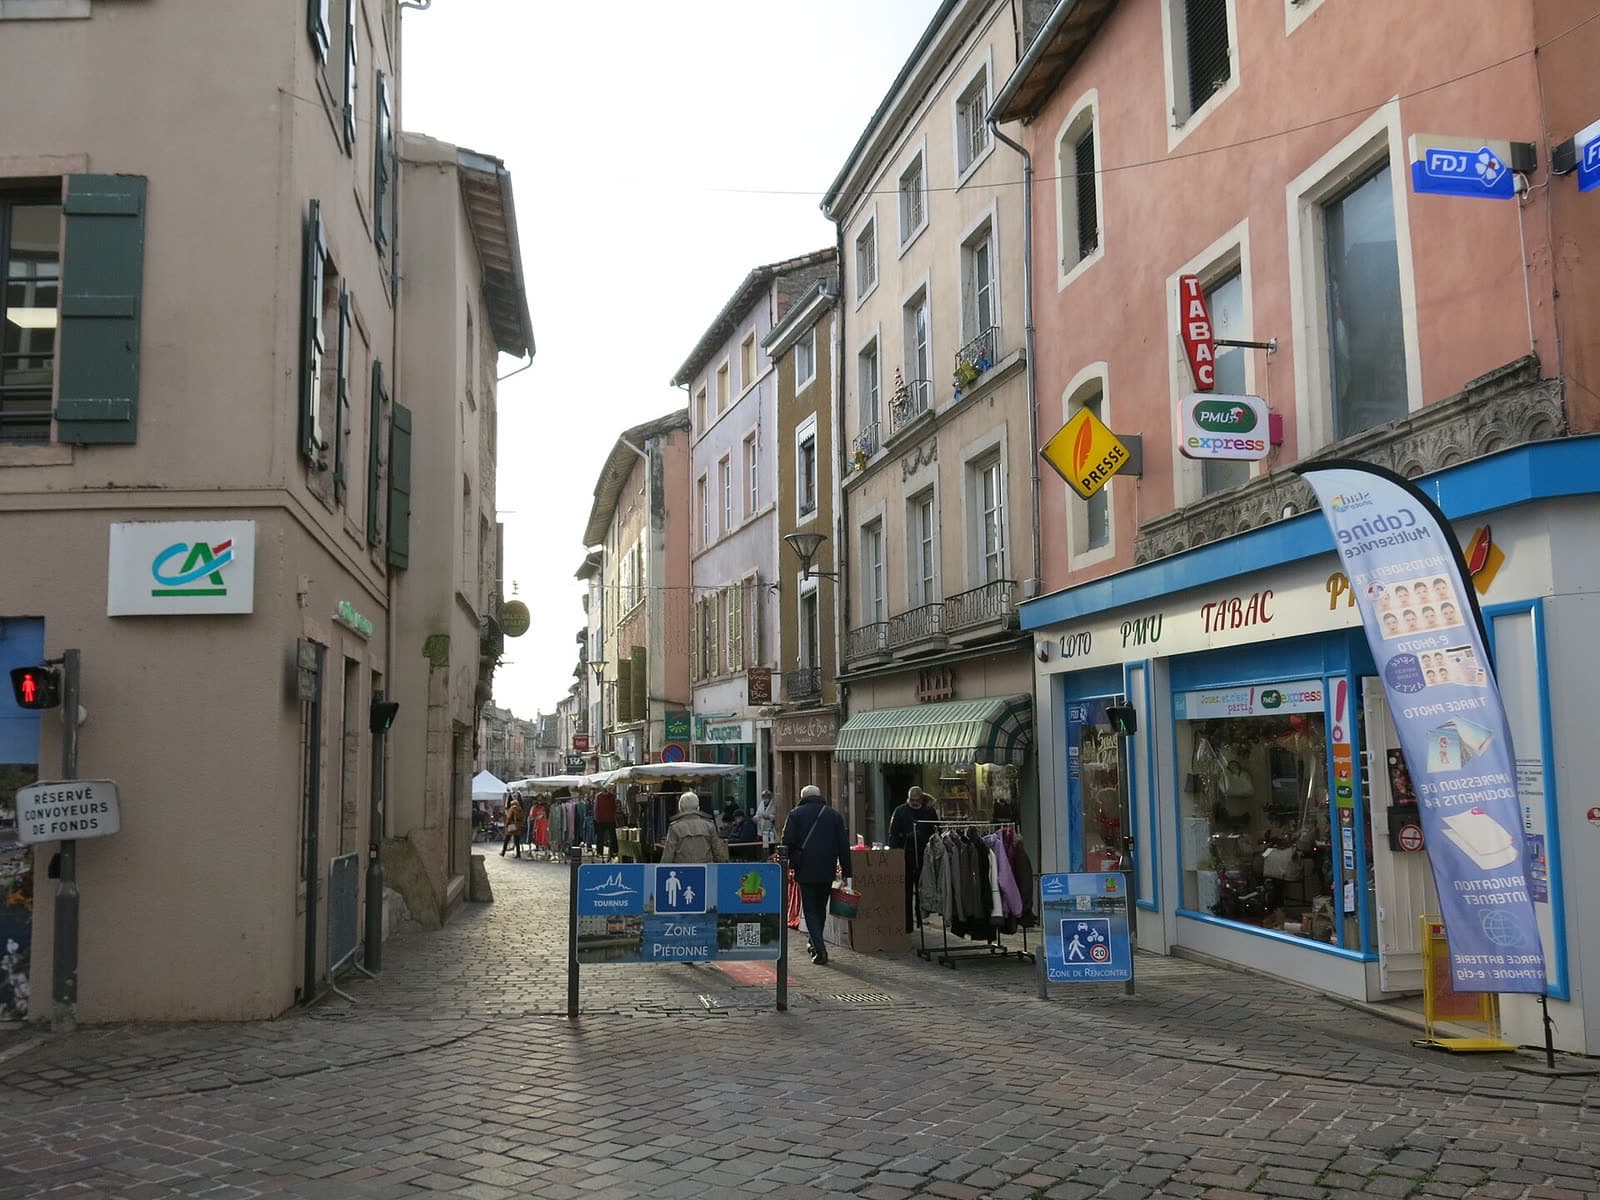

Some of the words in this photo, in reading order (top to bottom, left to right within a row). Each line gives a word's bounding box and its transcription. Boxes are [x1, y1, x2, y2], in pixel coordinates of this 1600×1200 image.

[1430, 153, 1467, 173] FDJ
[1184, 279, 1214, 385] TABAC
[1200, 410, 1230, 424] PMU
[1187, 436, 1265, 453] express
[1081, 446, 1125, 491] PRESSE
[1059, 631, 1092, 658] LOTO
[1120, 613, 1164, 648] PMU
[1200, 589, 1274, 633] TABAC
[1281, 690, 1322, 707] express
[34, 786, 94, 805] RÉSERVÉ
[24, 801, 109, 821] CONVOYEURS
[32, 823, 46, 836] DE
[51, 818, 98, 833] FONDS
[592, 899, 629, 907] TOURNUS
[1094, 948, 1105, 958] 20
